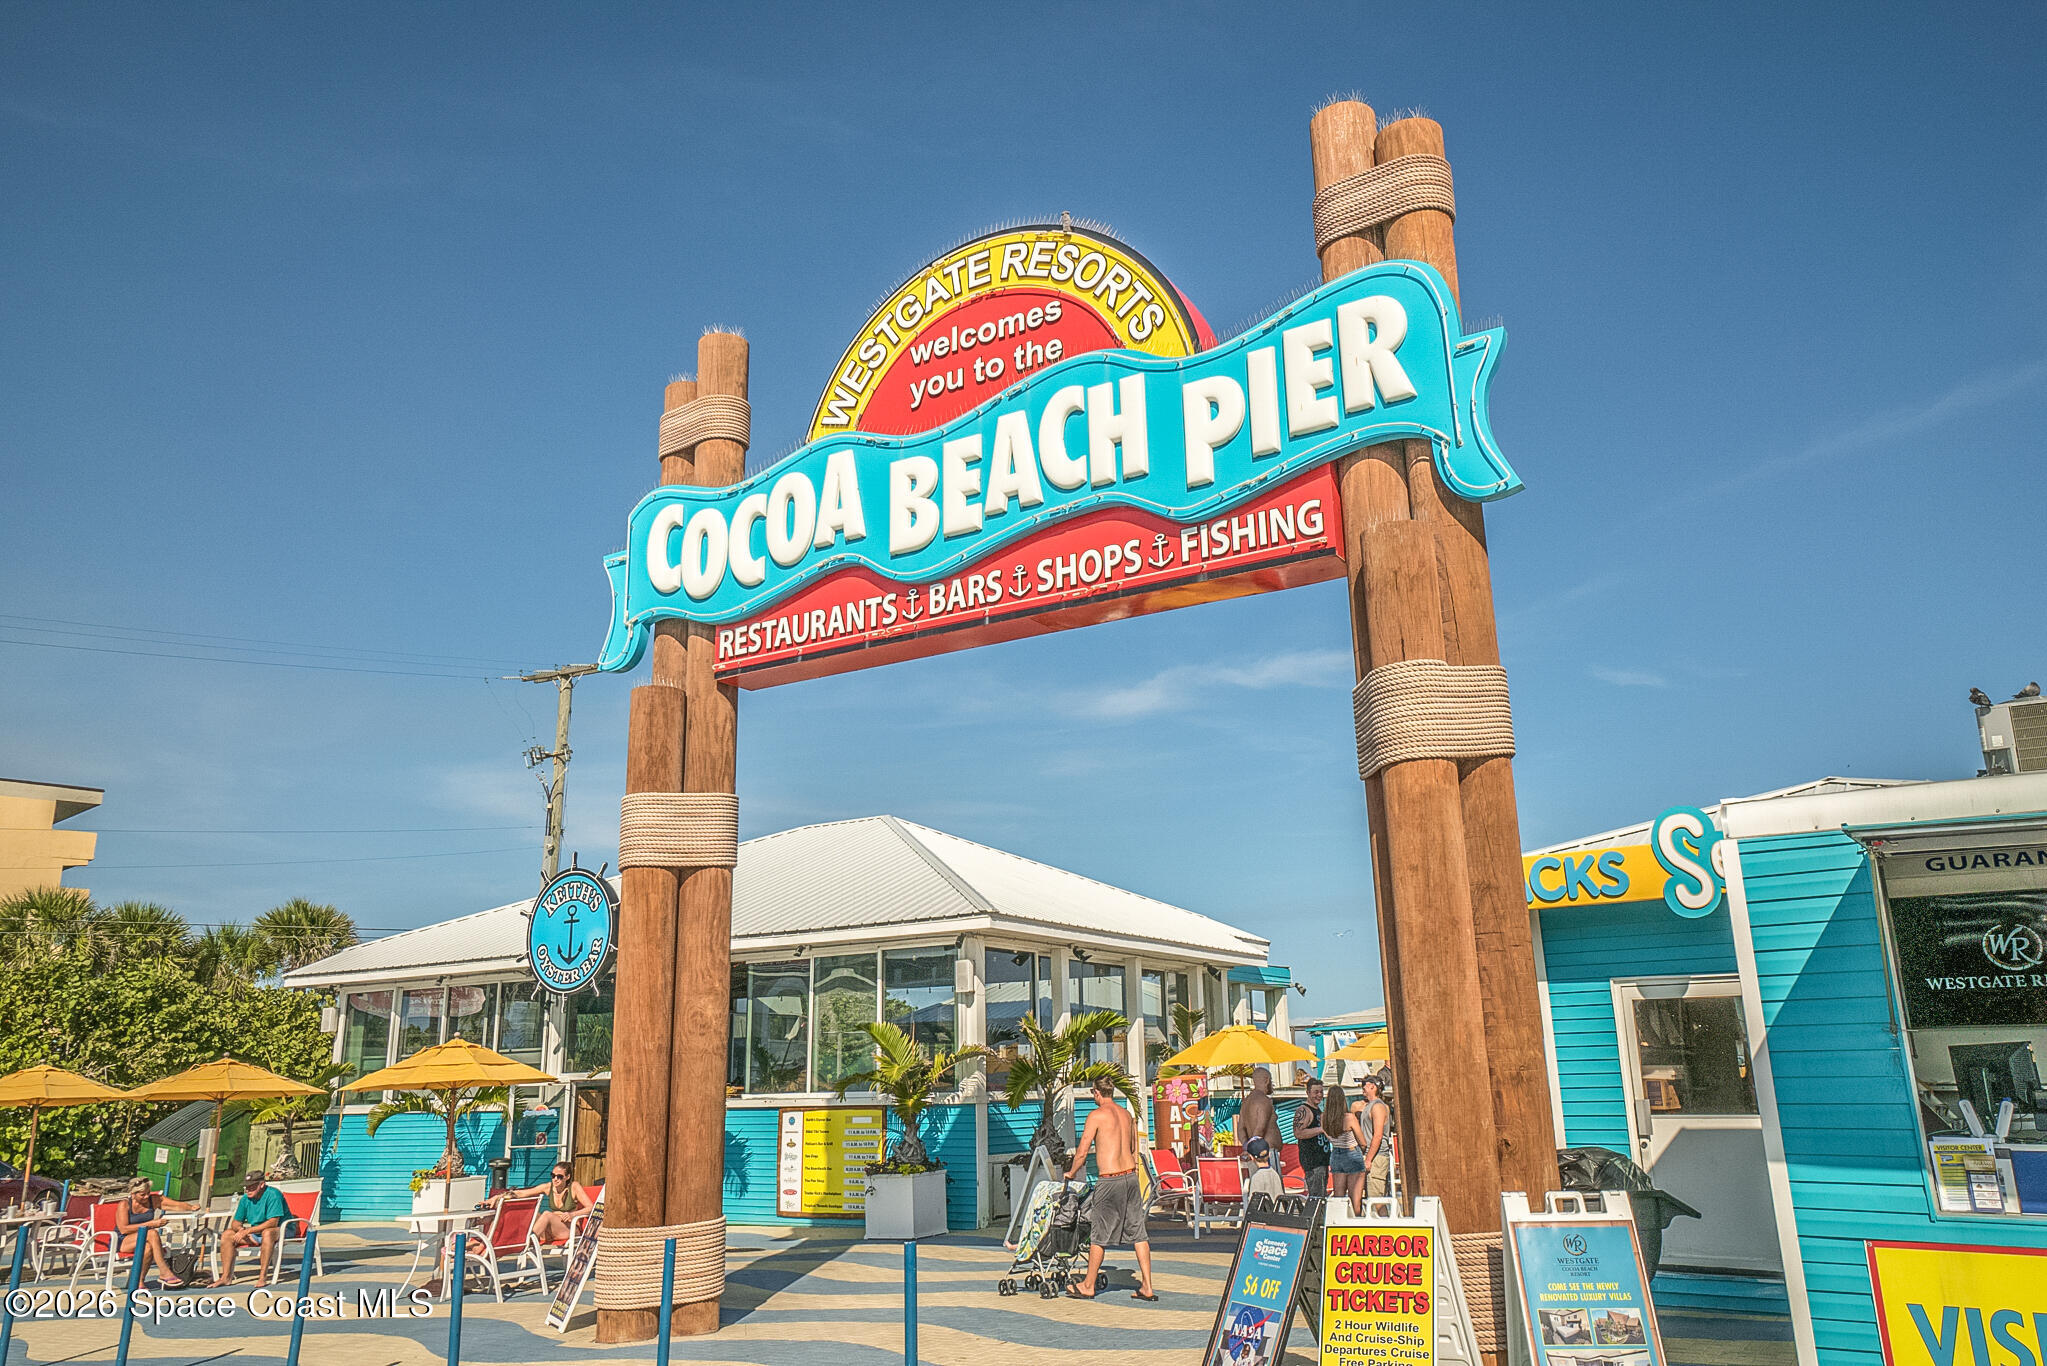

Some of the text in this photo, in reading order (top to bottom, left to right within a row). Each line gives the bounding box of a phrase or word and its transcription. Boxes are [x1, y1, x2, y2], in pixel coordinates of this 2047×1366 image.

[821, 241, 1165, 428] WESTGATE RESORTS
[910, 300, 1063, 365] welcomes
[909, 335, 1063, 408] you to the
[647, 295, 1417, 599] COCOA BEACH PIER
[718, 499, 1325, 660] RESTAURANTS BARS SHOPS FISHING
[541, 881, 603, 917] KEITH'S
[537, 937, 603, 984] OYSTER BAR
[1926, 974, 2047, 990] WESTGATE R
[1254, 1240, 1288, 1256] Space
[1264, 1238, 1288, 1248] Kennedy
[1330, 1235, 1429, 1257] HARBOR
[1263, 1253, 1281, 1262] Center
[1335, 1262, 1422, 1286] CRUISE
[1243, 1274, 1281, 1300] $6 OFF
[1548, 1282, 1619, 1291] COME SEE THE NEWLY
[1327, 1289, 1430, 1314] TICKETS
[1539, 1292, 1632, 1301] RENOVATED LUXURY VILLAS
[1232, 1324, 1262, 1340] NASA
[1335, 1320, 1420, 1332] 2 Hour Wildlife
[1330, 1332, 1424, 1348] And Cruise-Ship
[1324, 1344, 1430, 1359] Departures Cruise
[1340, 1358, 1364, 1366] Free
